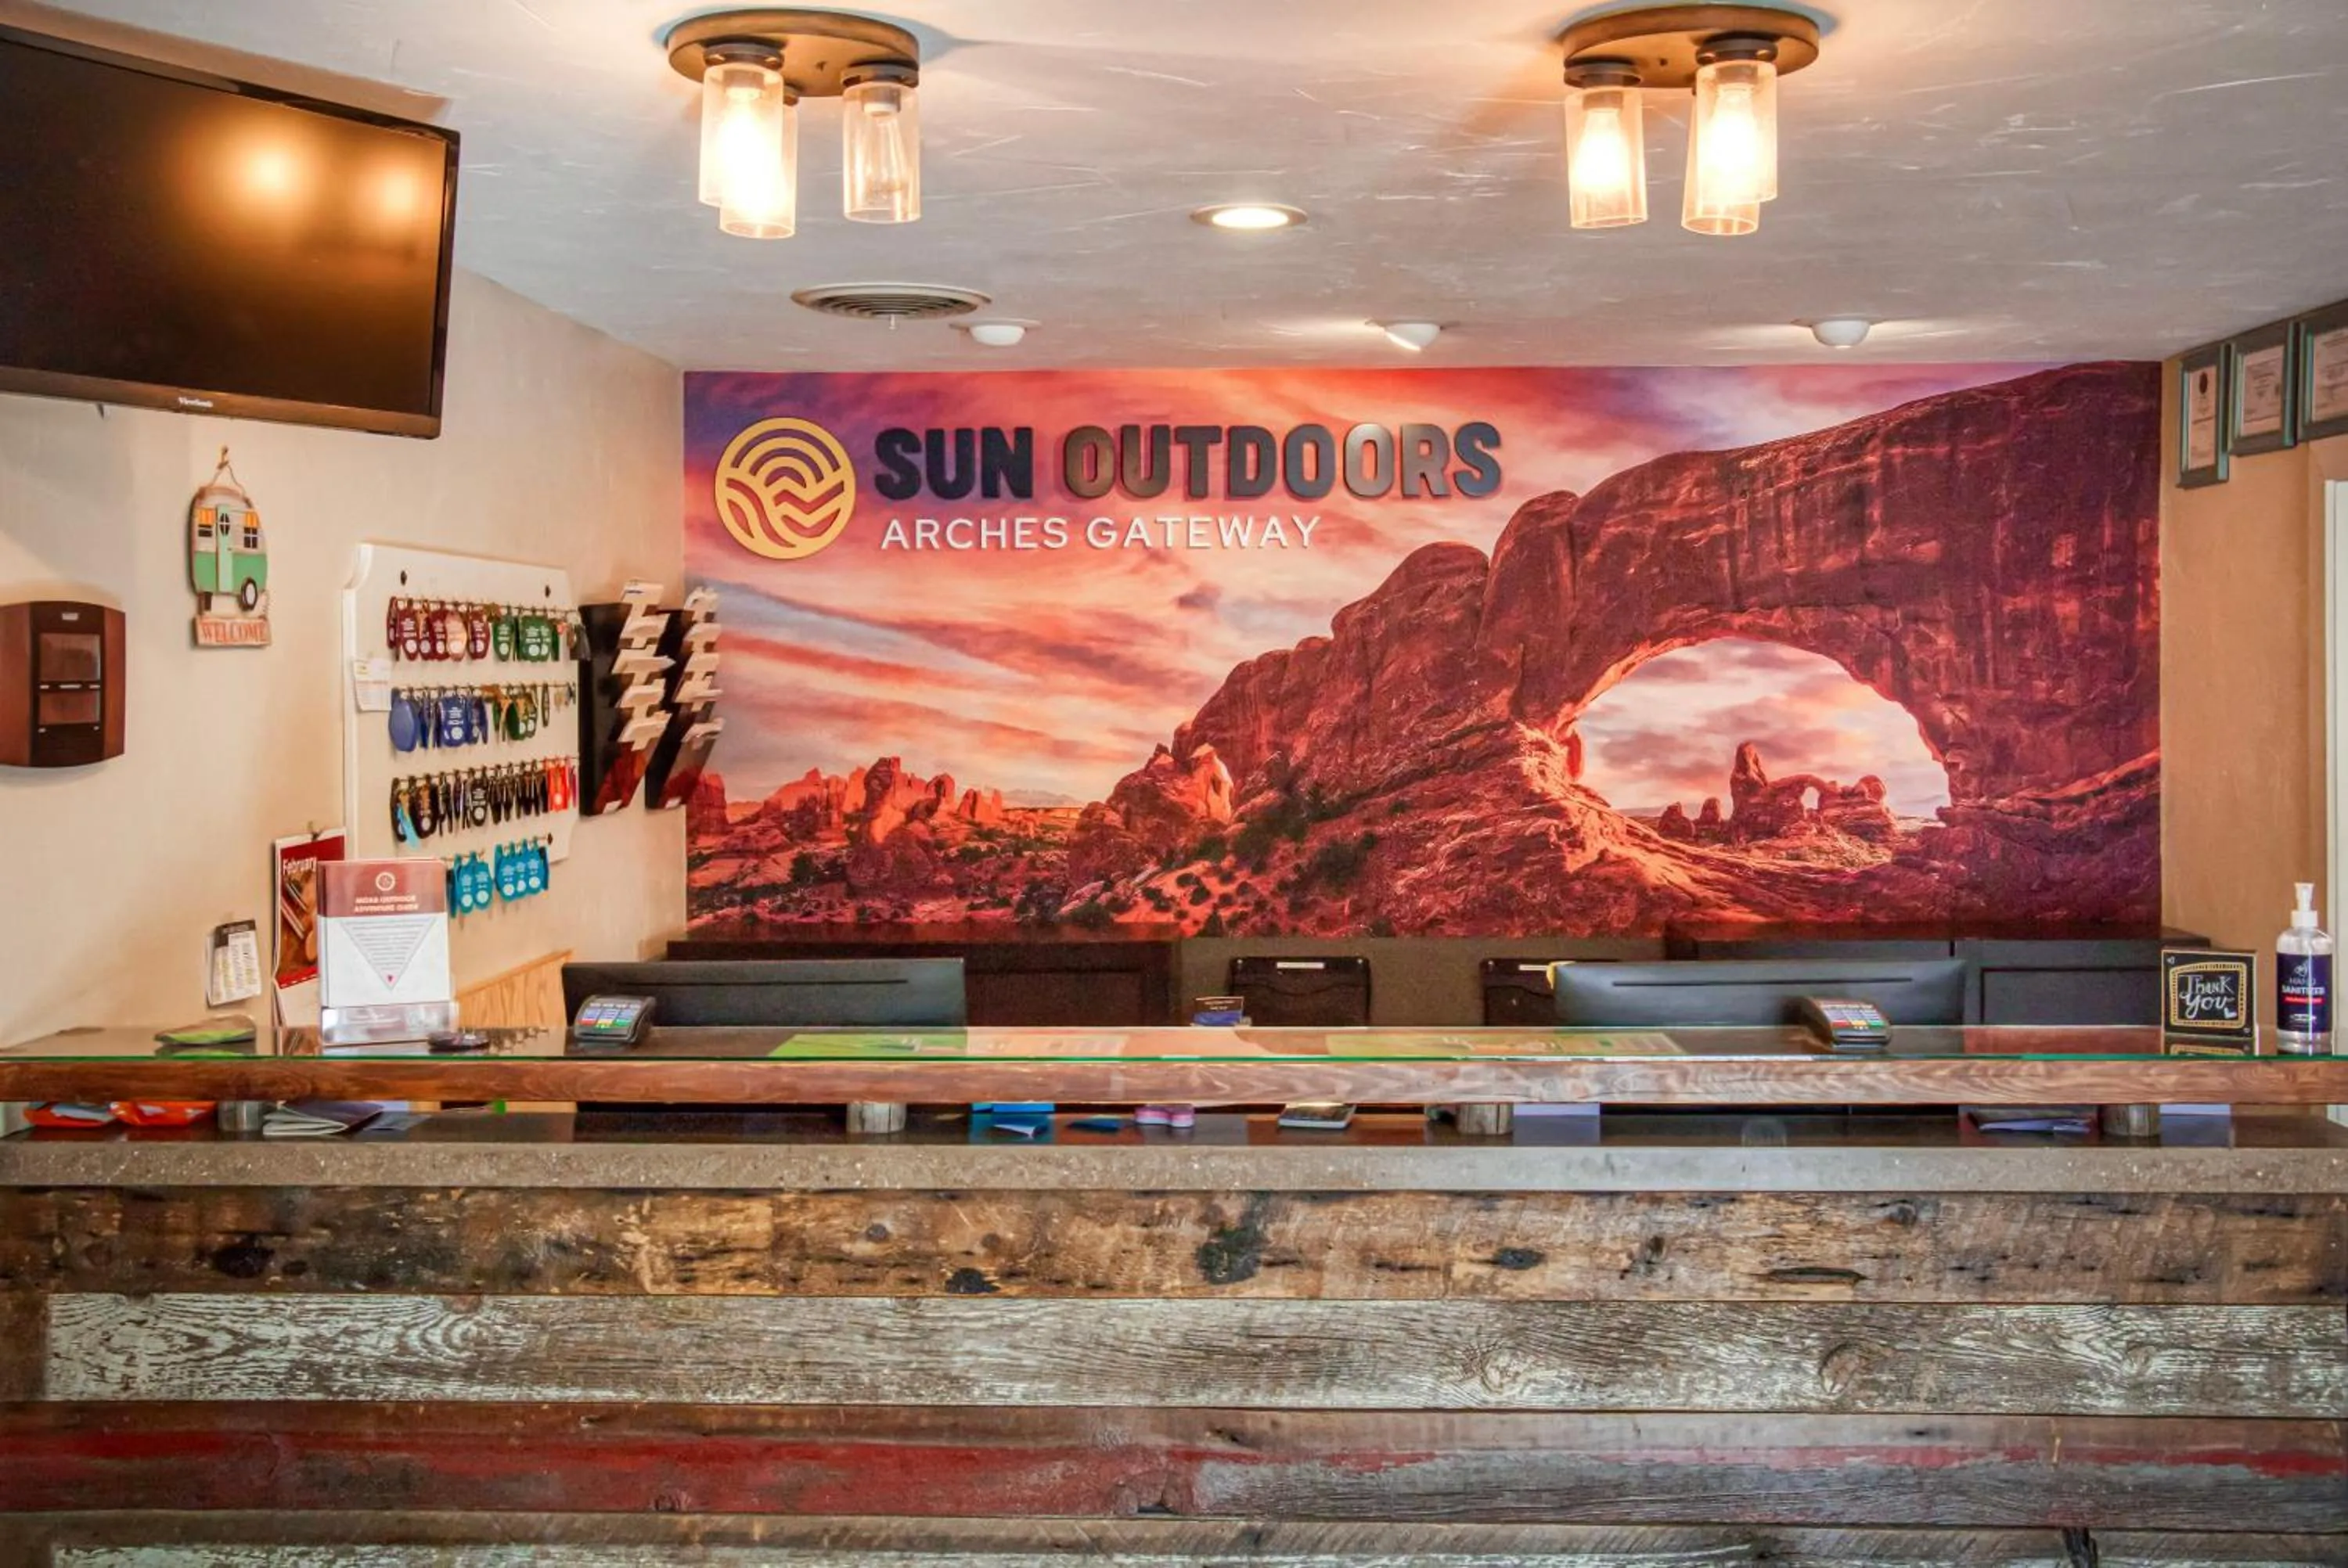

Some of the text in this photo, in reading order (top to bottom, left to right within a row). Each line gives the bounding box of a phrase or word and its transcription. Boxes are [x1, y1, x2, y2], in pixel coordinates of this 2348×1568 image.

[874, 422, 1502, 500] SUN OUTDOORS
[881, 516, 1321, 550] ARCHES GATEWAY
[201, 622, 266, 643] WELCOME
